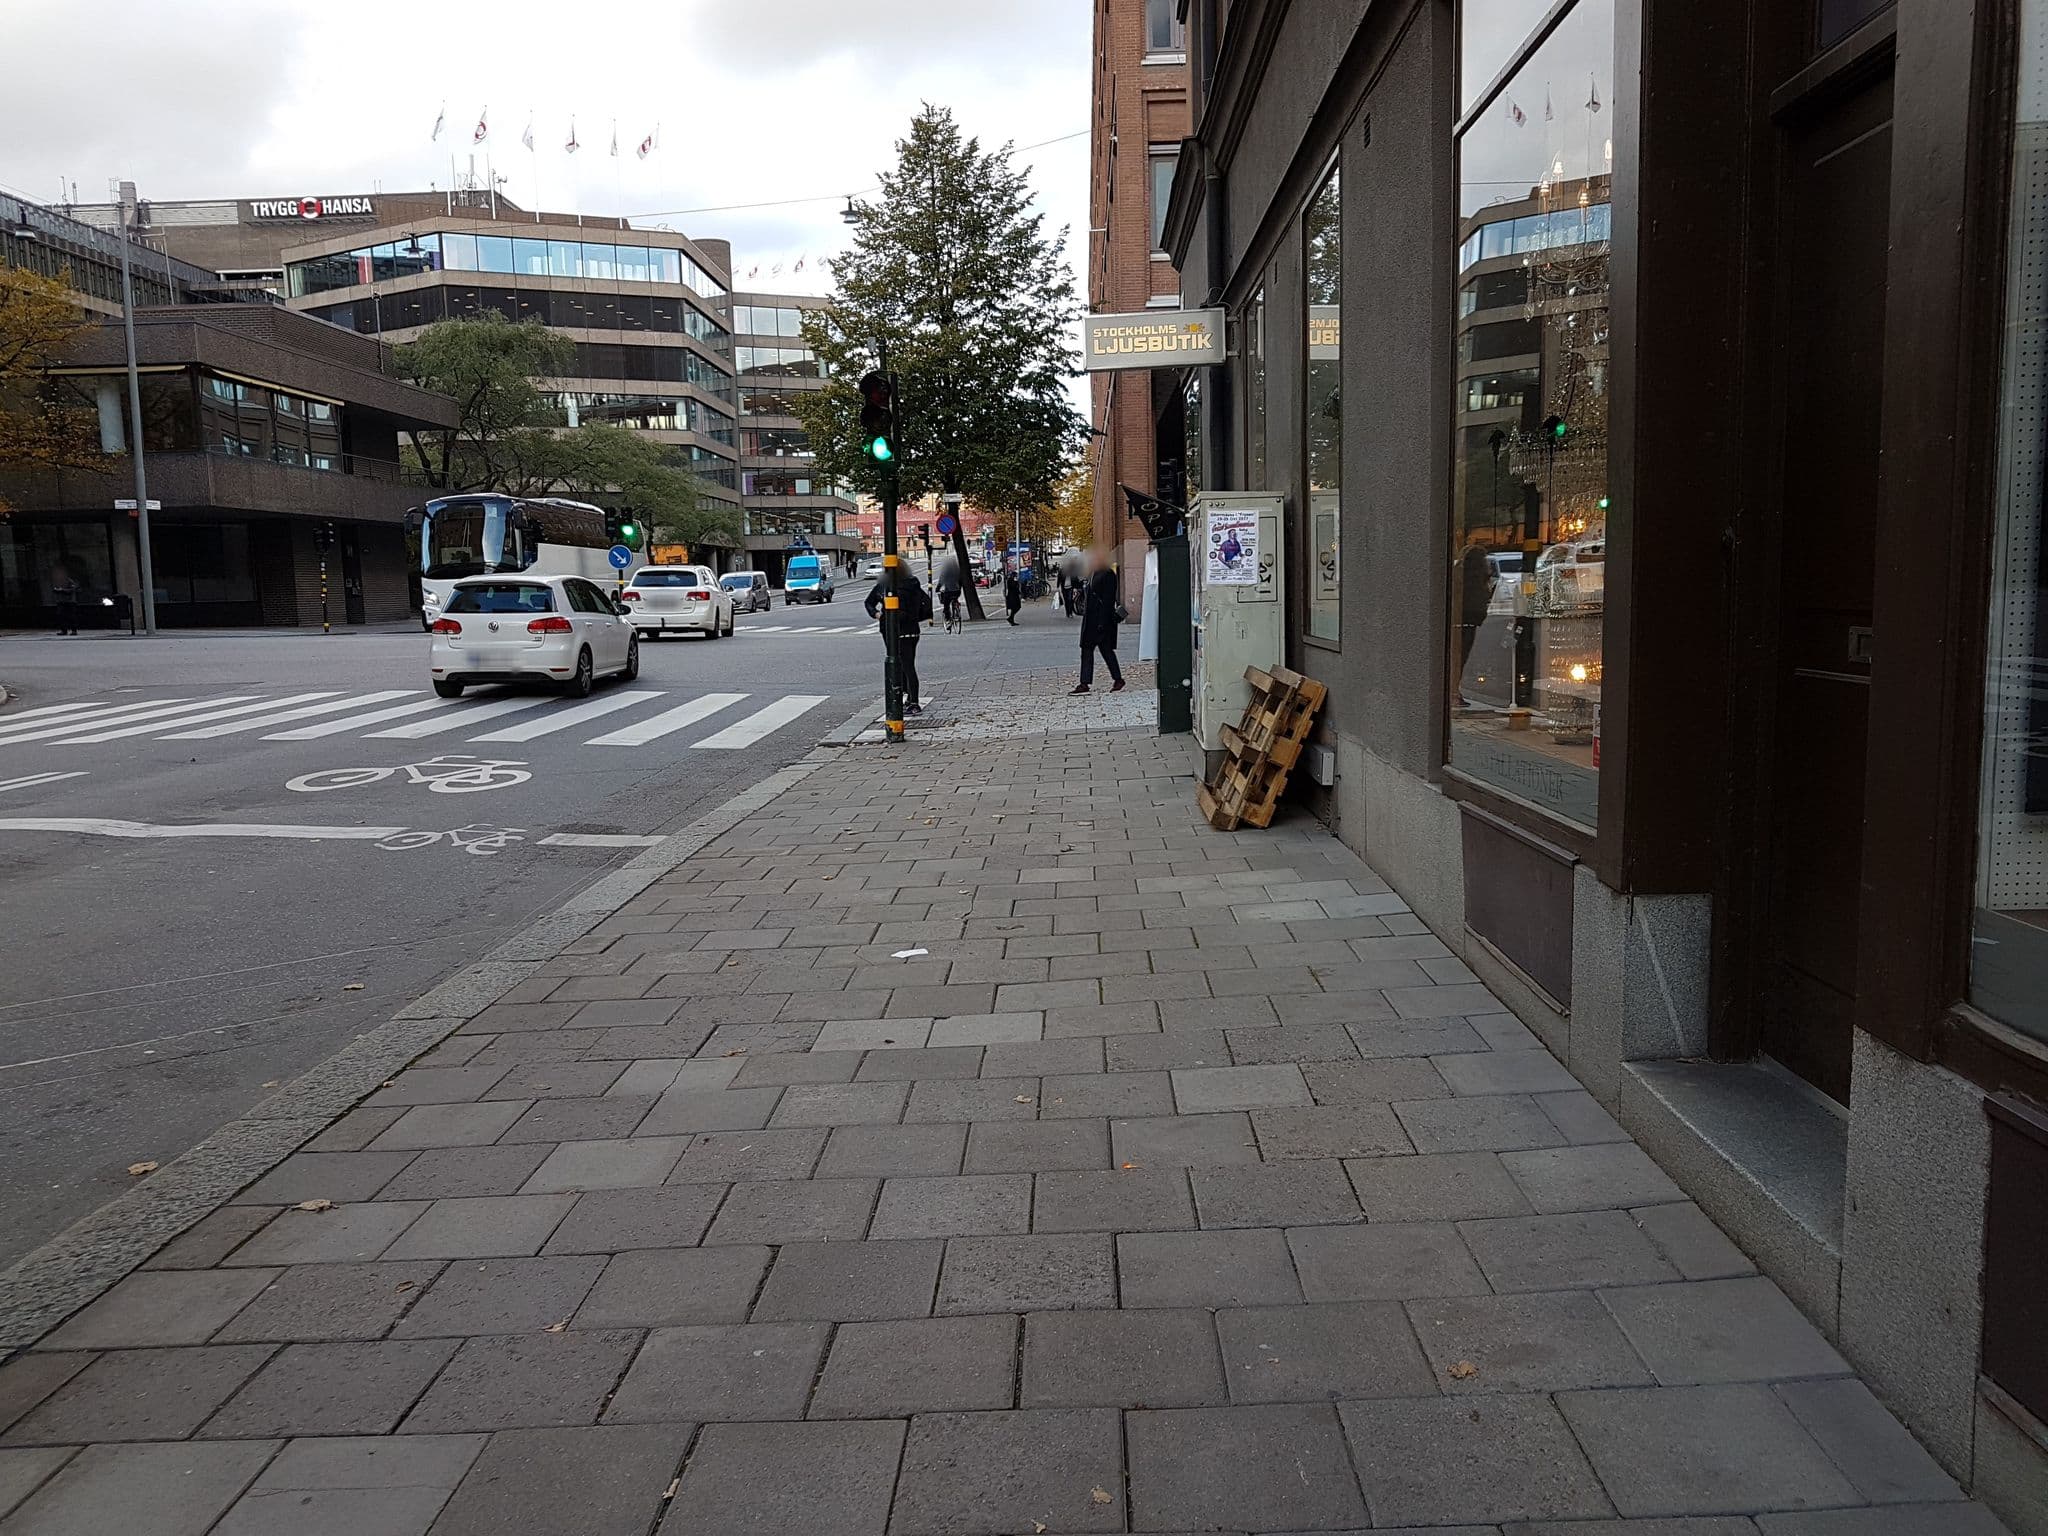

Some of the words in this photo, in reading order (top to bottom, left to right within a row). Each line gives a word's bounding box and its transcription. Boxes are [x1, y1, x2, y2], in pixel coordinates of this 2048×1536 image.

[250, 201, 298, 216] TRYGG
[321, 198, 373, 213] HANSA
[1093, 324, 1177, 337] STOCKHOLMS
[1093, 333, 1214, 354] LJUSBUTIK
